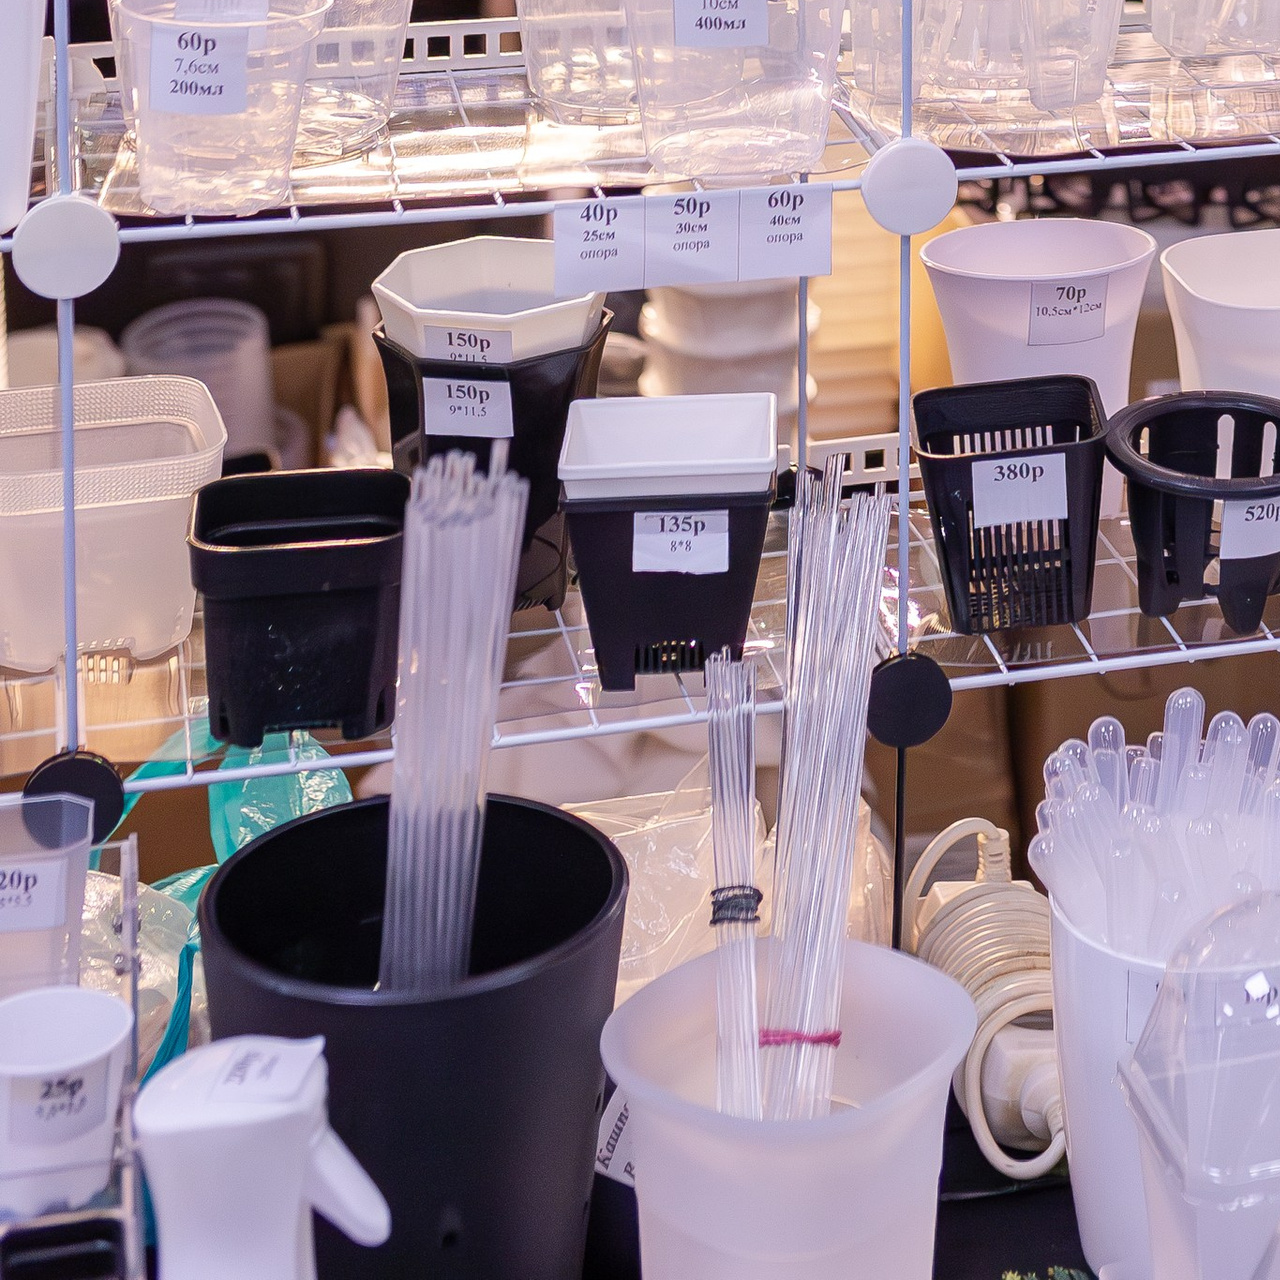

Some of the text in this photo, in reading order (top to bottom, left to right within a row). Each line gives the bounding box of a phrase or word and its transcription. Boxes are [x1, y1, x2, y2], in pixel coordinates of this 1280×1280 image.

[694, 16, 747, 30] 400мл
[177, 31, 217, 57] 60р
[173, 58, 220, 75] 7,6см
[169, 79, 224, 96] 200мл
[673, 196, 711, 218] 50р
[767, 190, 804, 211] 60р
[579, 202, 618, 226] 40р
[769, 215, 801, 227] 40см
[582, 229, 616, 243] 25см
[675, 222, 708, 235] 30см
[766, 231, 804, 244] опора
[579, 247, 618, 261] опора
[672, 240, 711, 253] опора
[1056, 285, 1087, 304] 70р
[447, 331, 491, 352] 150р
[446, 383, 490, 405] 150р
[993, 462, 1044, 483] 380р
[659, 515, 706, 536] 135р
